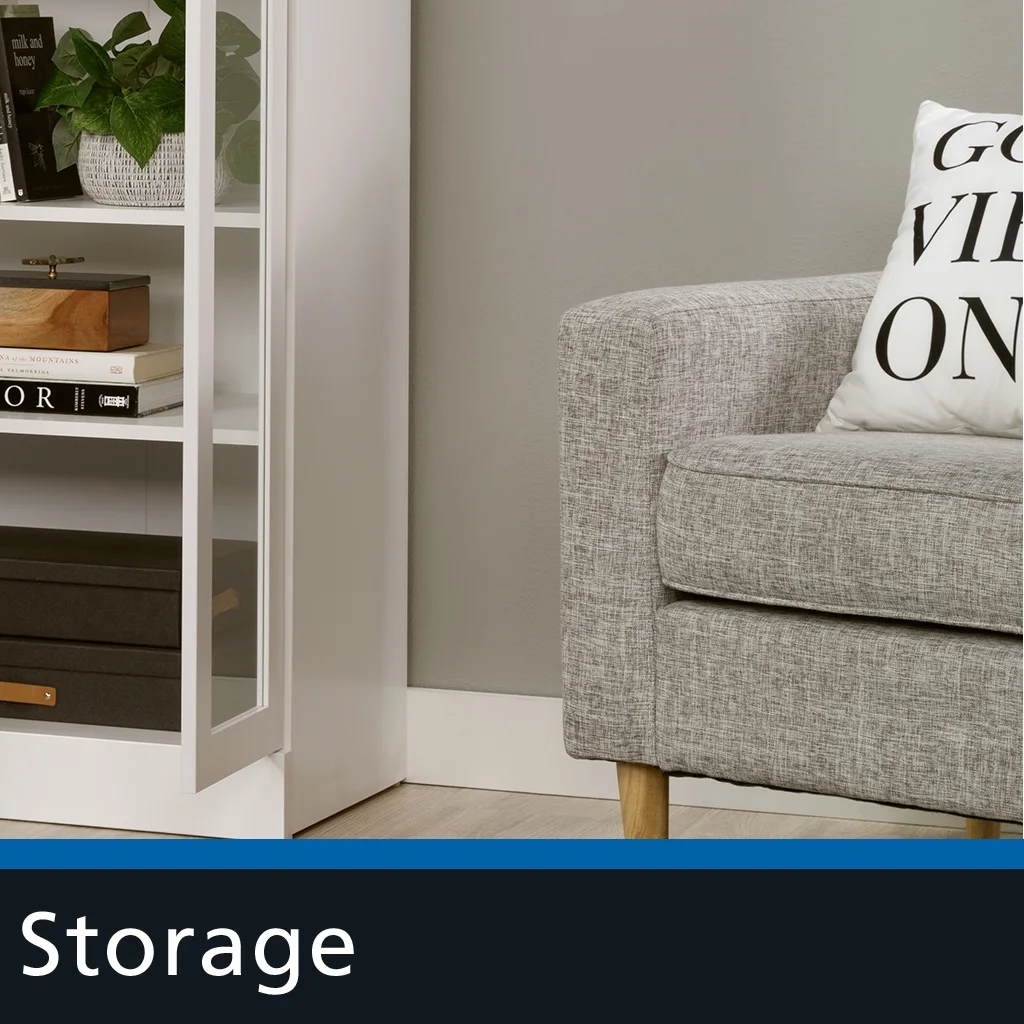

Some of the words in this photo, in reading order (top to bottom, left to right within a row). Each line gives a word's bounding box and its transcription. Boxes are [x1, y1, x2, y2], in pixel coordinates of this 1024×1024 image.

[12, 34, 28, 49] milk
[30, 34, 43, 48] and
[13, 52, 36, 70] honey
[29, 356, 79, 364] MOUNTAINS
